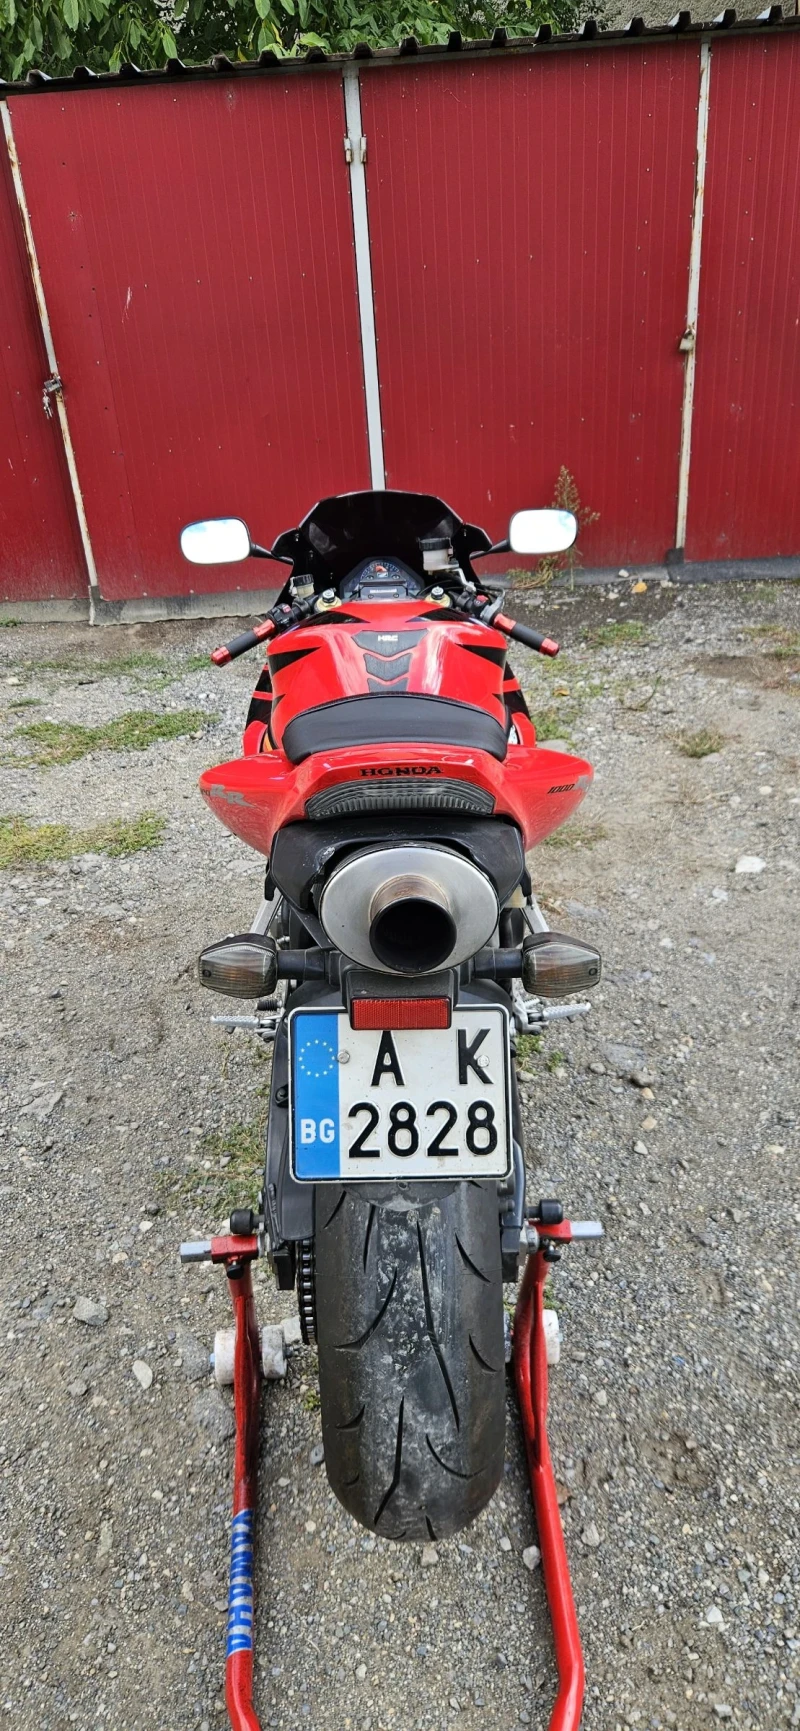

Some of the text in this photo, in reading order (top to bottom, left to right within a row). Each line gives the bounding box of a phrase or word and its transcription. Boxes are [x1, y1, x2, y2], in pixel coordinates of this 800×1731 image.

[377, 634, 399, 642] HRC
[360, 765, 442, 777] HONDA
[370, 1028, 494, 1086] A K
[300, 1118, 335, 1144] BG
[348, 1100, 498, 1158] 2828
